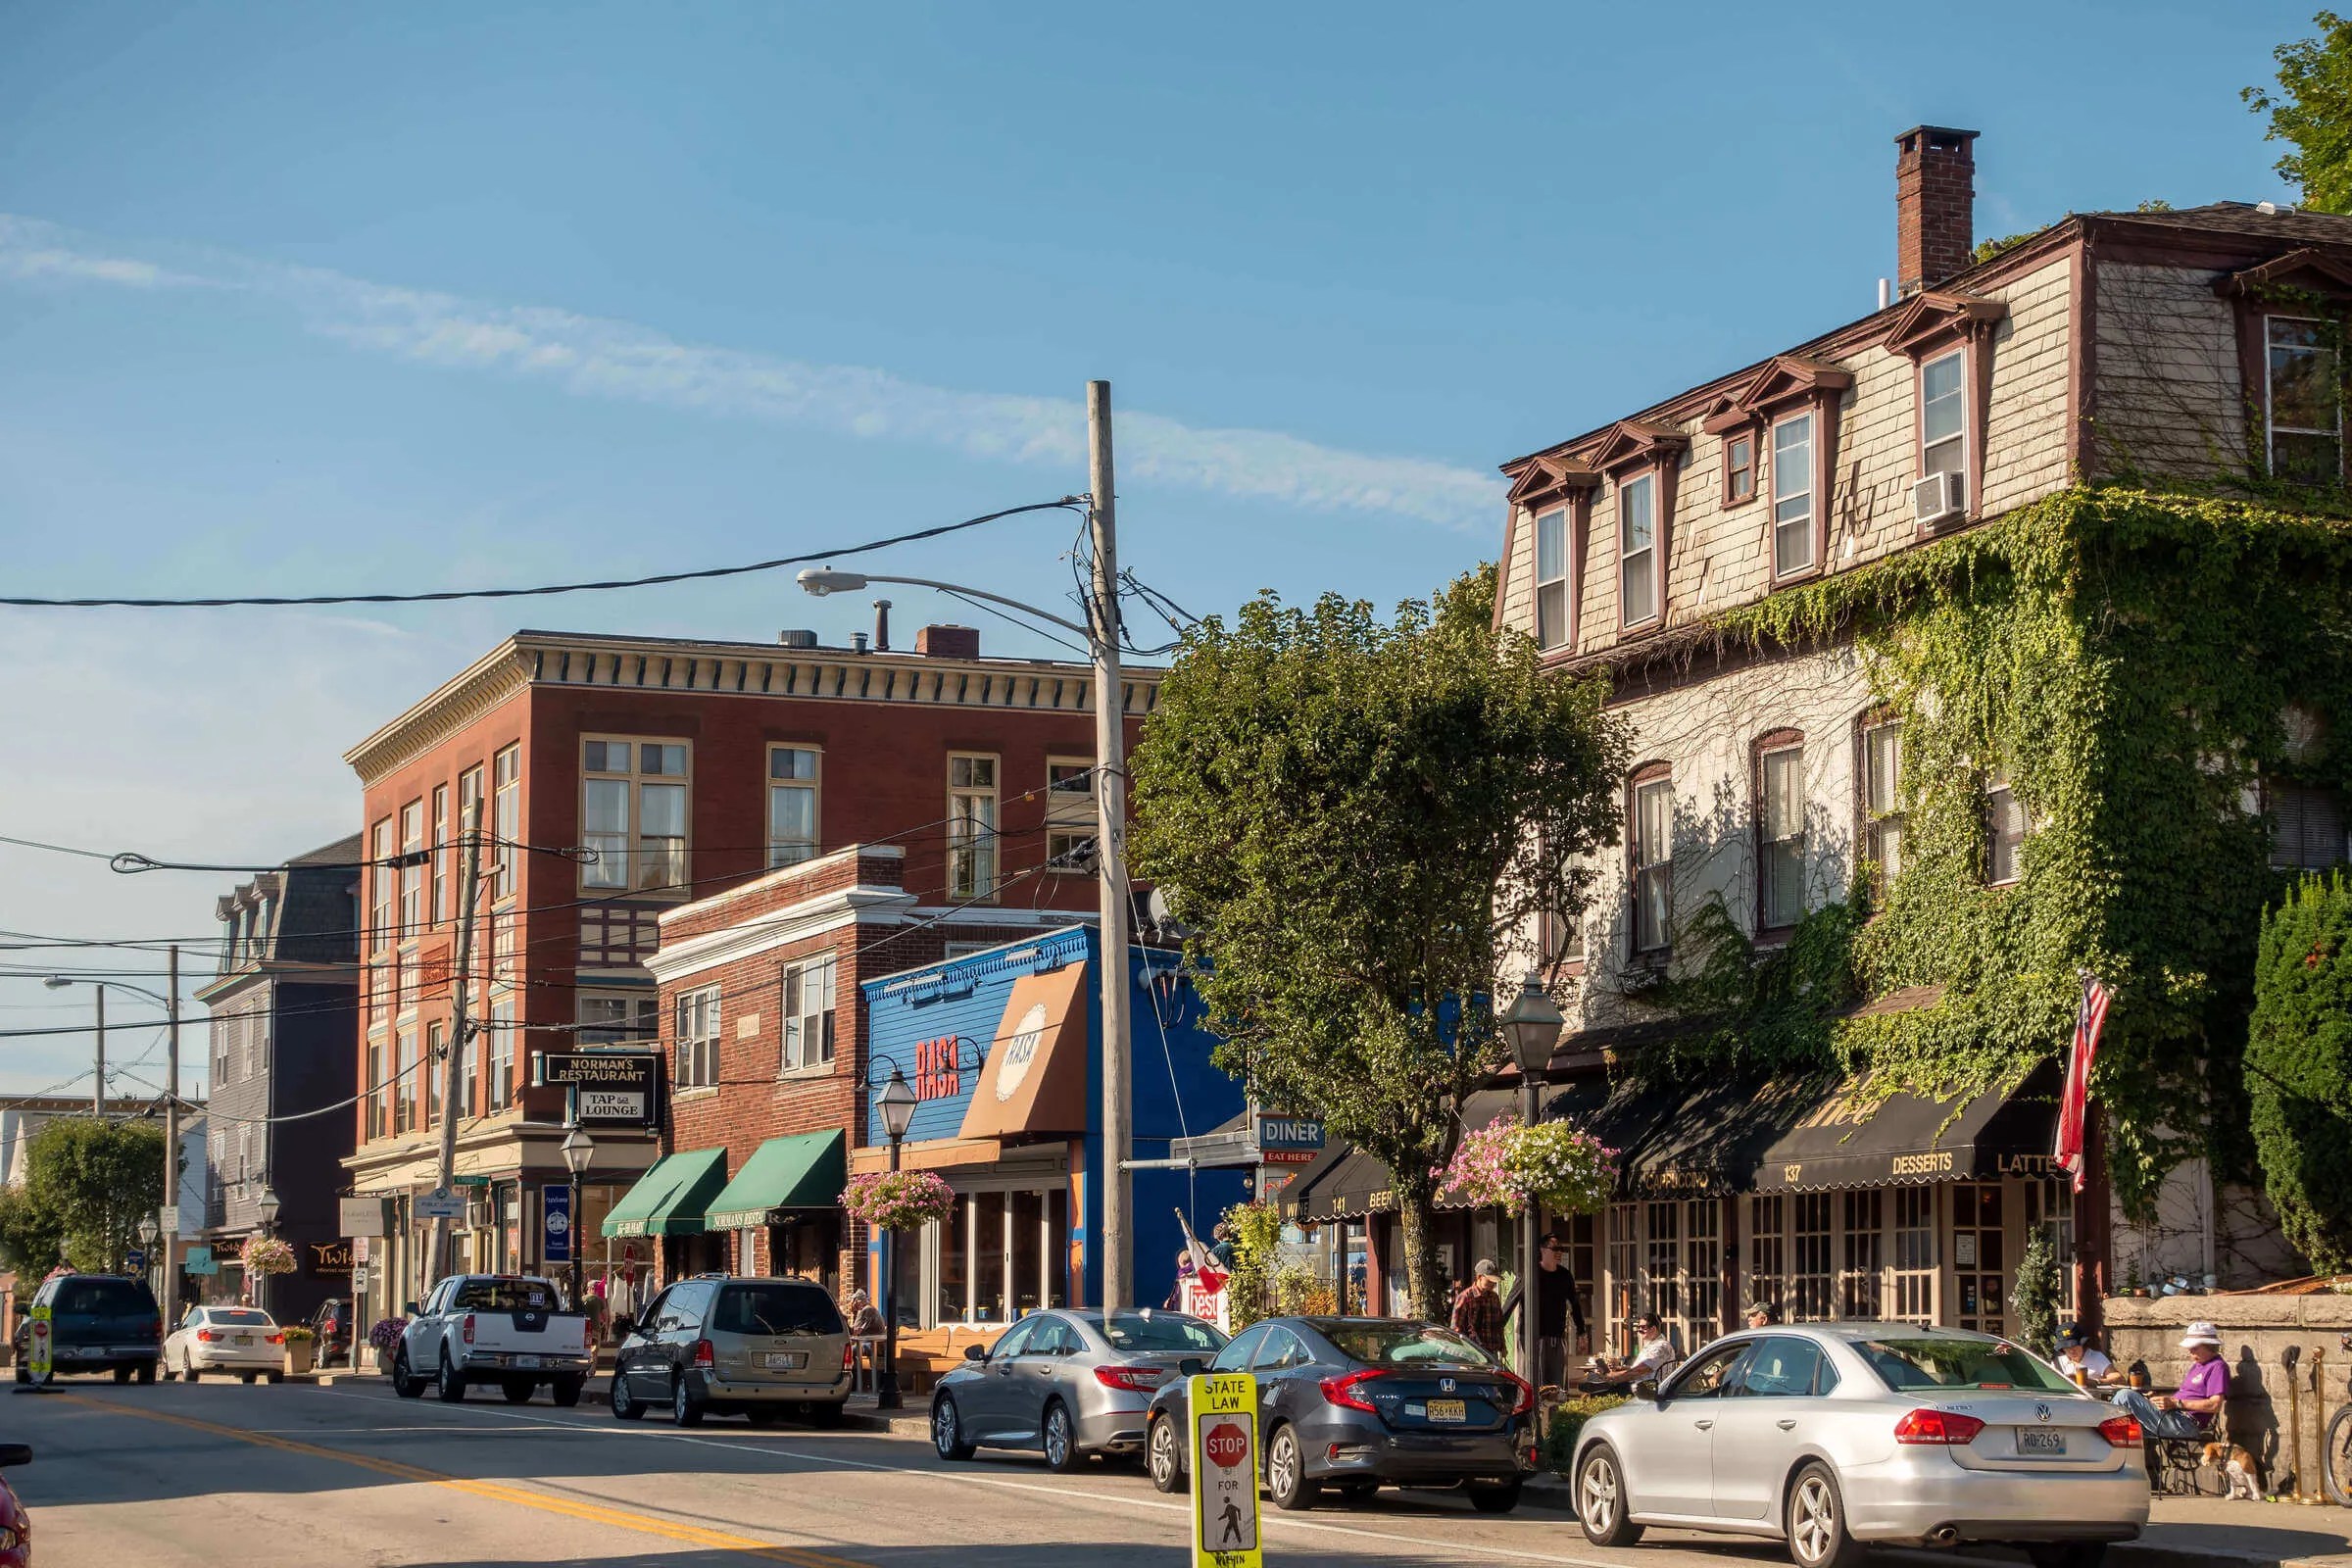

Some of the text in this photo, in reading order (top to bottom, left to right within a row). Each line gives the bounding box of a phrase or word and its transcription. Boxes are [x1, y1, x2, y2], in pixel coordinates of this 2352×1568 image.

[1005, 1034, 1037, 1066] RASA
[570, 1059, 634, 1070] NORMAN'S
[916, 1035, 959, 1102] RASA
[560, 1070, 645, 1082] RESTAURANT
[590, 1095, 614, 1104] TAP
[585, 1105, 638, 1115] LOUNGE
[1265, 1121, 1318, 1142] DINER
[1268, 1152, 1314, 1161] EAT HERE
[1892, 1152, 1952, 1174] DESSERTS
[1645, 1171, 1709, 1191] CAPPUCCINO
[1784, 1164, 1802, 1183] 137
[1332, 1197, 1347, 1213] 141
[1369, 1190, 1393, 1208] BEER
[1287, 1200, 1308, 1217] WINE
[1212, 1396, 1240, 1410] LAW
[1209, 1438, 1245, 1454] STOP
[1217, 1481, 1239, 1491] FOR
